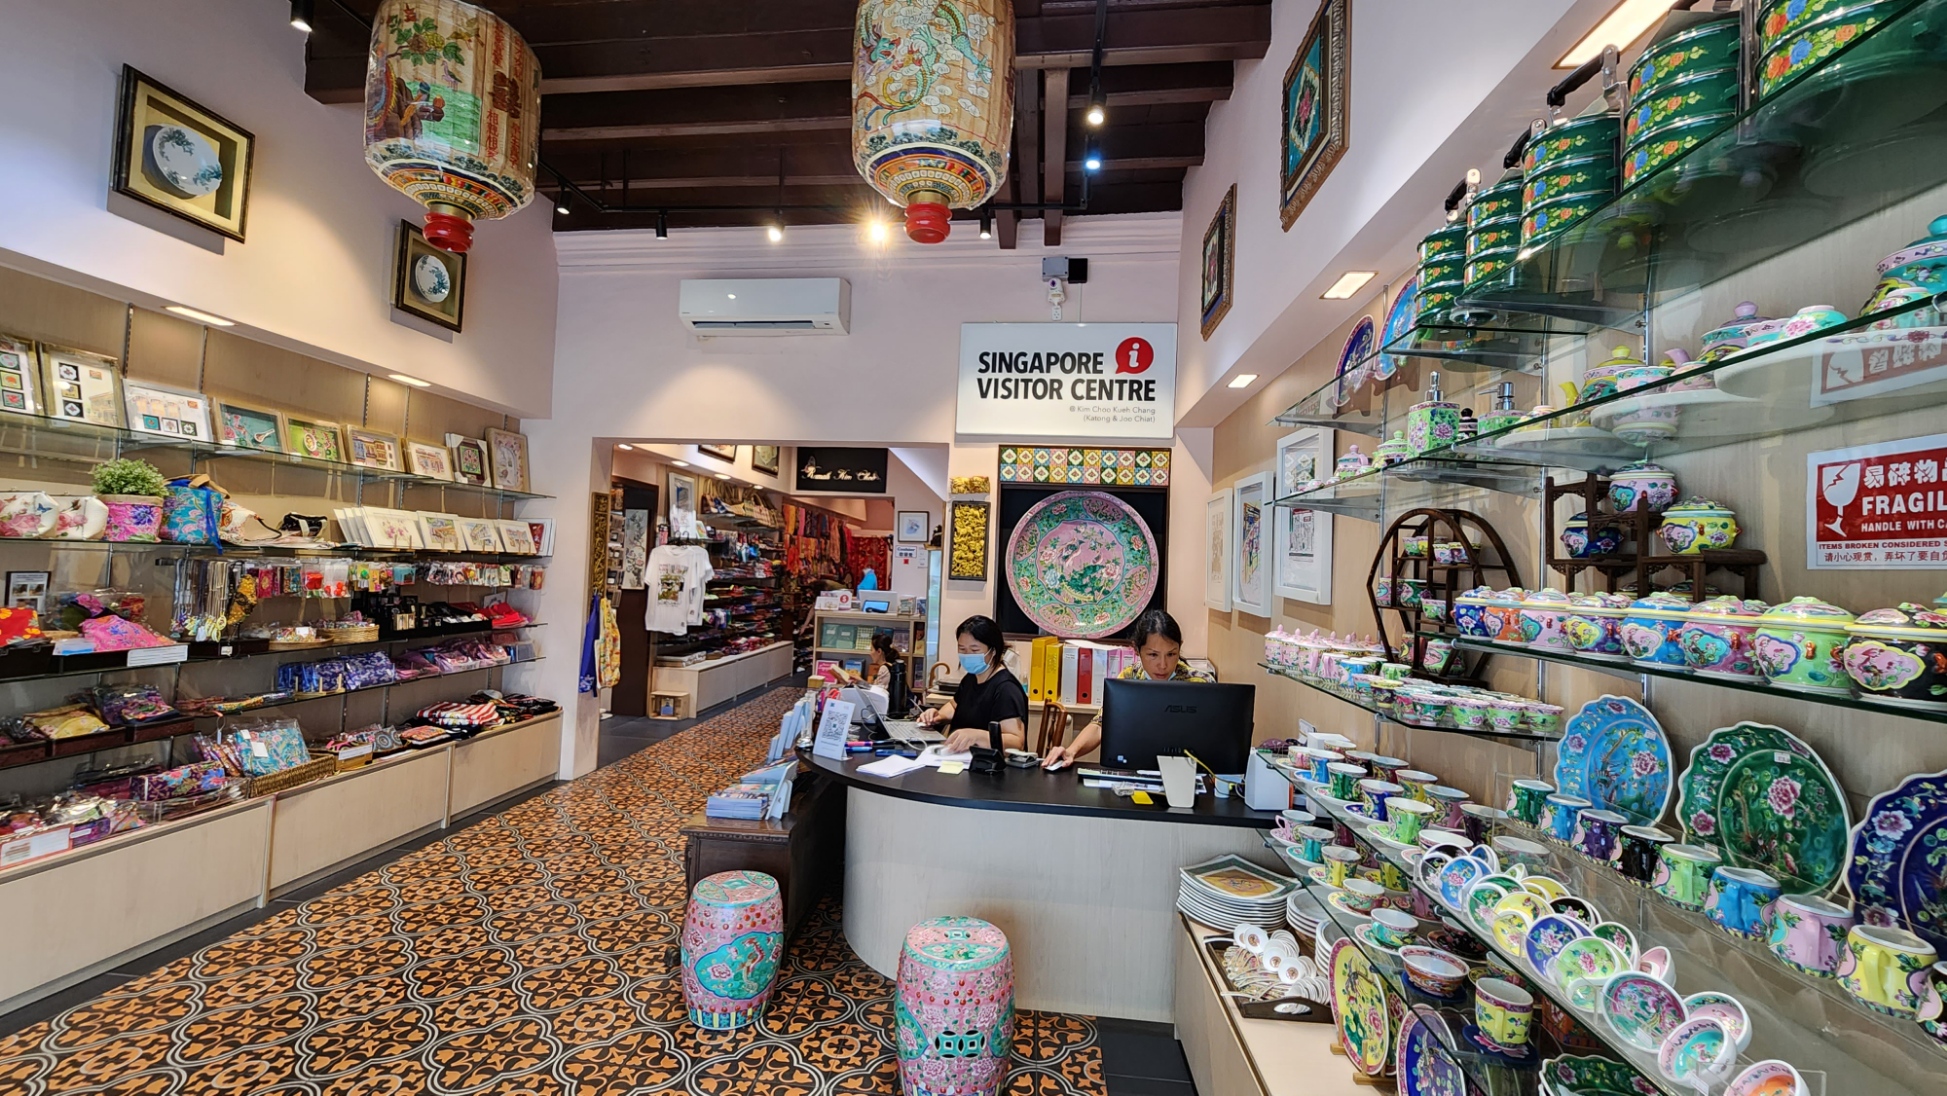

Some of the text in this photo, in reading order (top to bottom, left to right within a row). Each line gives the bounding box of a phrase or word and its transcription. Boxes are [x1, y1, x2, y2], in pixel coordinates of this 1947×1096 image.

[977, 351, 1104, 374] SINGAPORE
[977, 378, 1156, 402] VISITOR CENTRE
[1112, 406, 1131, 414] Kueh
[1132, 406, 1156, 415] Chang
[1083, 414, 1111, 424] (Katong
[1134, 415, 1156, 423] Chiat)
[1863, 457, 1947, 489] 易碎物
[1861, 521, 1902, 533] HANDLE
[1907, 519, 1935, 531] WITH
[1845, 542, 1879, 550] BROKEN
[1881, 540, 1941, 549] CONSIDERED
[1164, 704, 1198, 714] ASUS
